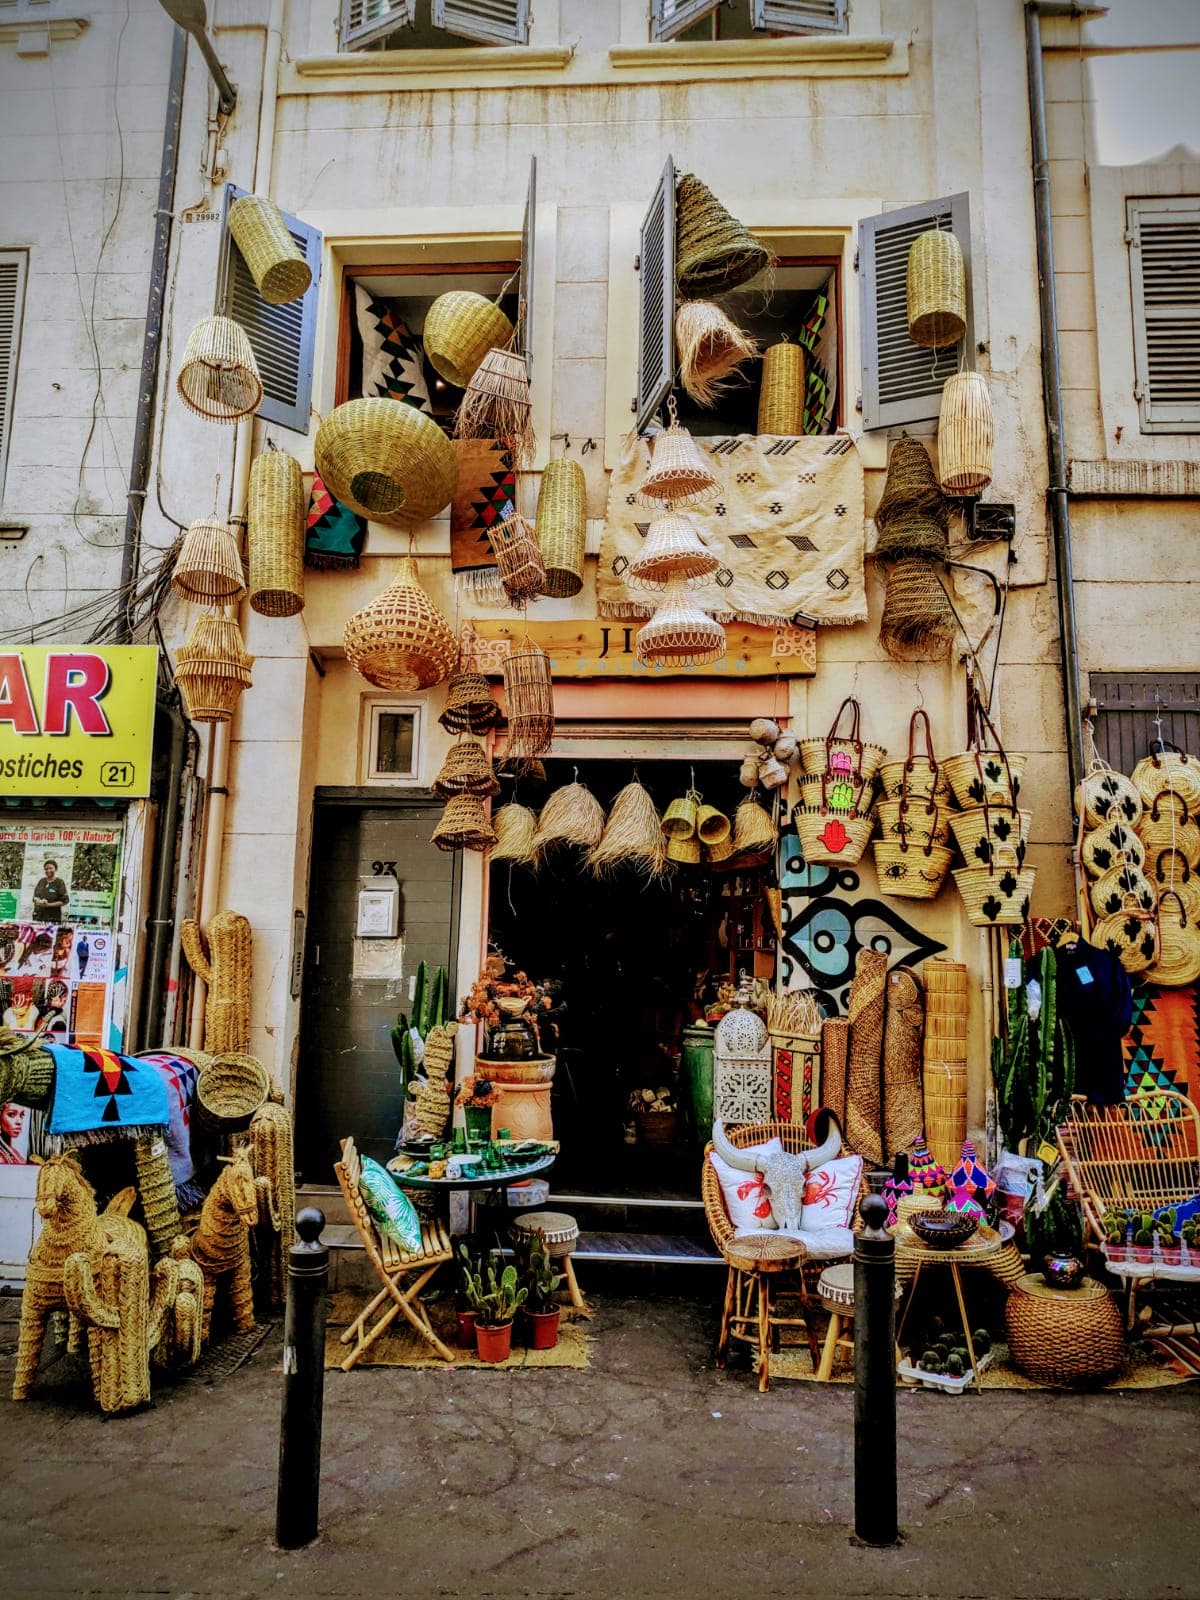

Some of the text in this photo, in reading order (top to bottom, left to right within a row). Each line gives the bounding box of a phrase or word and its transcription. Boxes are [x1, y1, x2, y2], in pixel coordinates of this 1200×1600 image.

[599, 628, 633, 658] JI
[0, 653, 112, 736] AR
[108, 766, 128, 782] 21
[59, 830, 80, 841] 100%
[371, 861, 398, 878] 93
